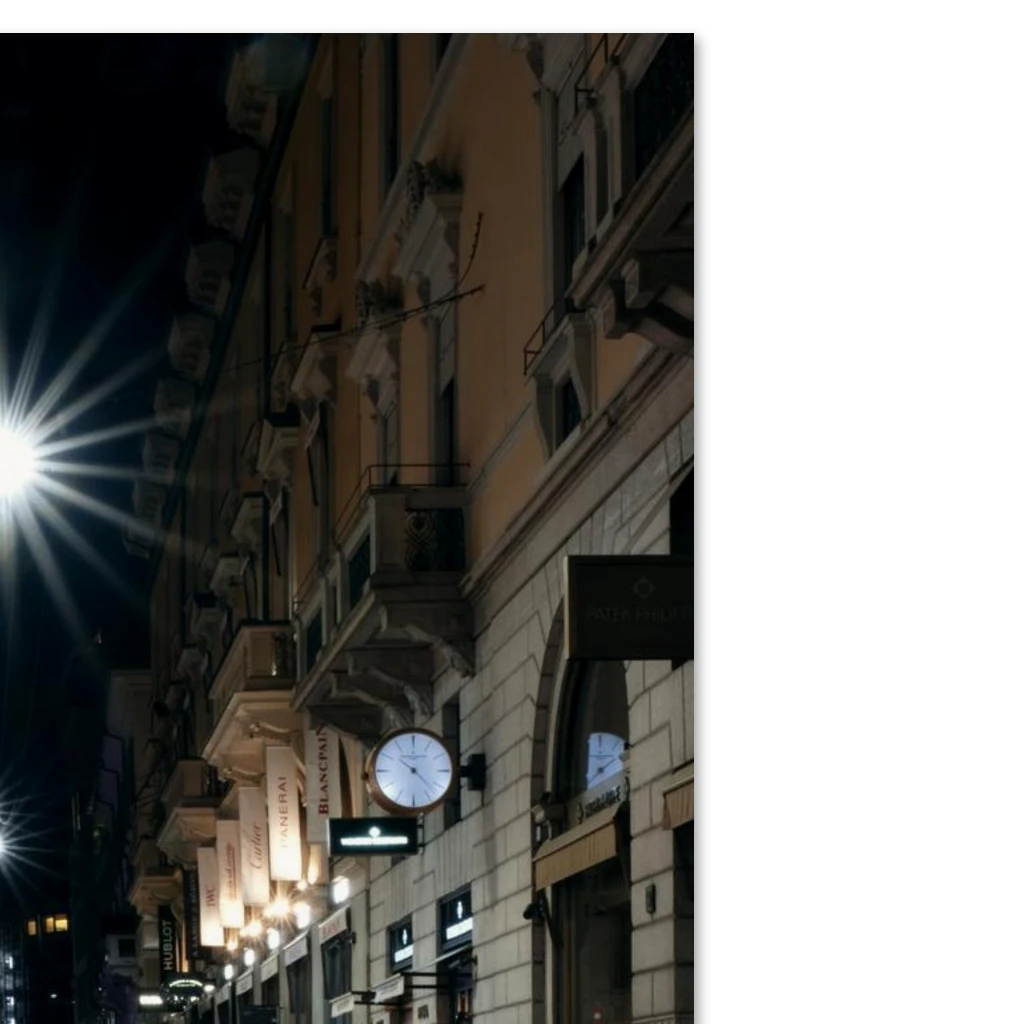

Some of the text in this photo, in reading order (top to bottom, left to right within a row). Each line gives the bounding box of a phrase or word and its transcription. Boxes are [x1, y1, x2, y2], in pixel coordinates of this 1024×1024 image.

[277, 776, 289, 848] PANERAI
[248, 822, 263, 870] Cartier
[205, 884, 216, 907] IWC
[162, 919, 175, 971] HUBLOT
